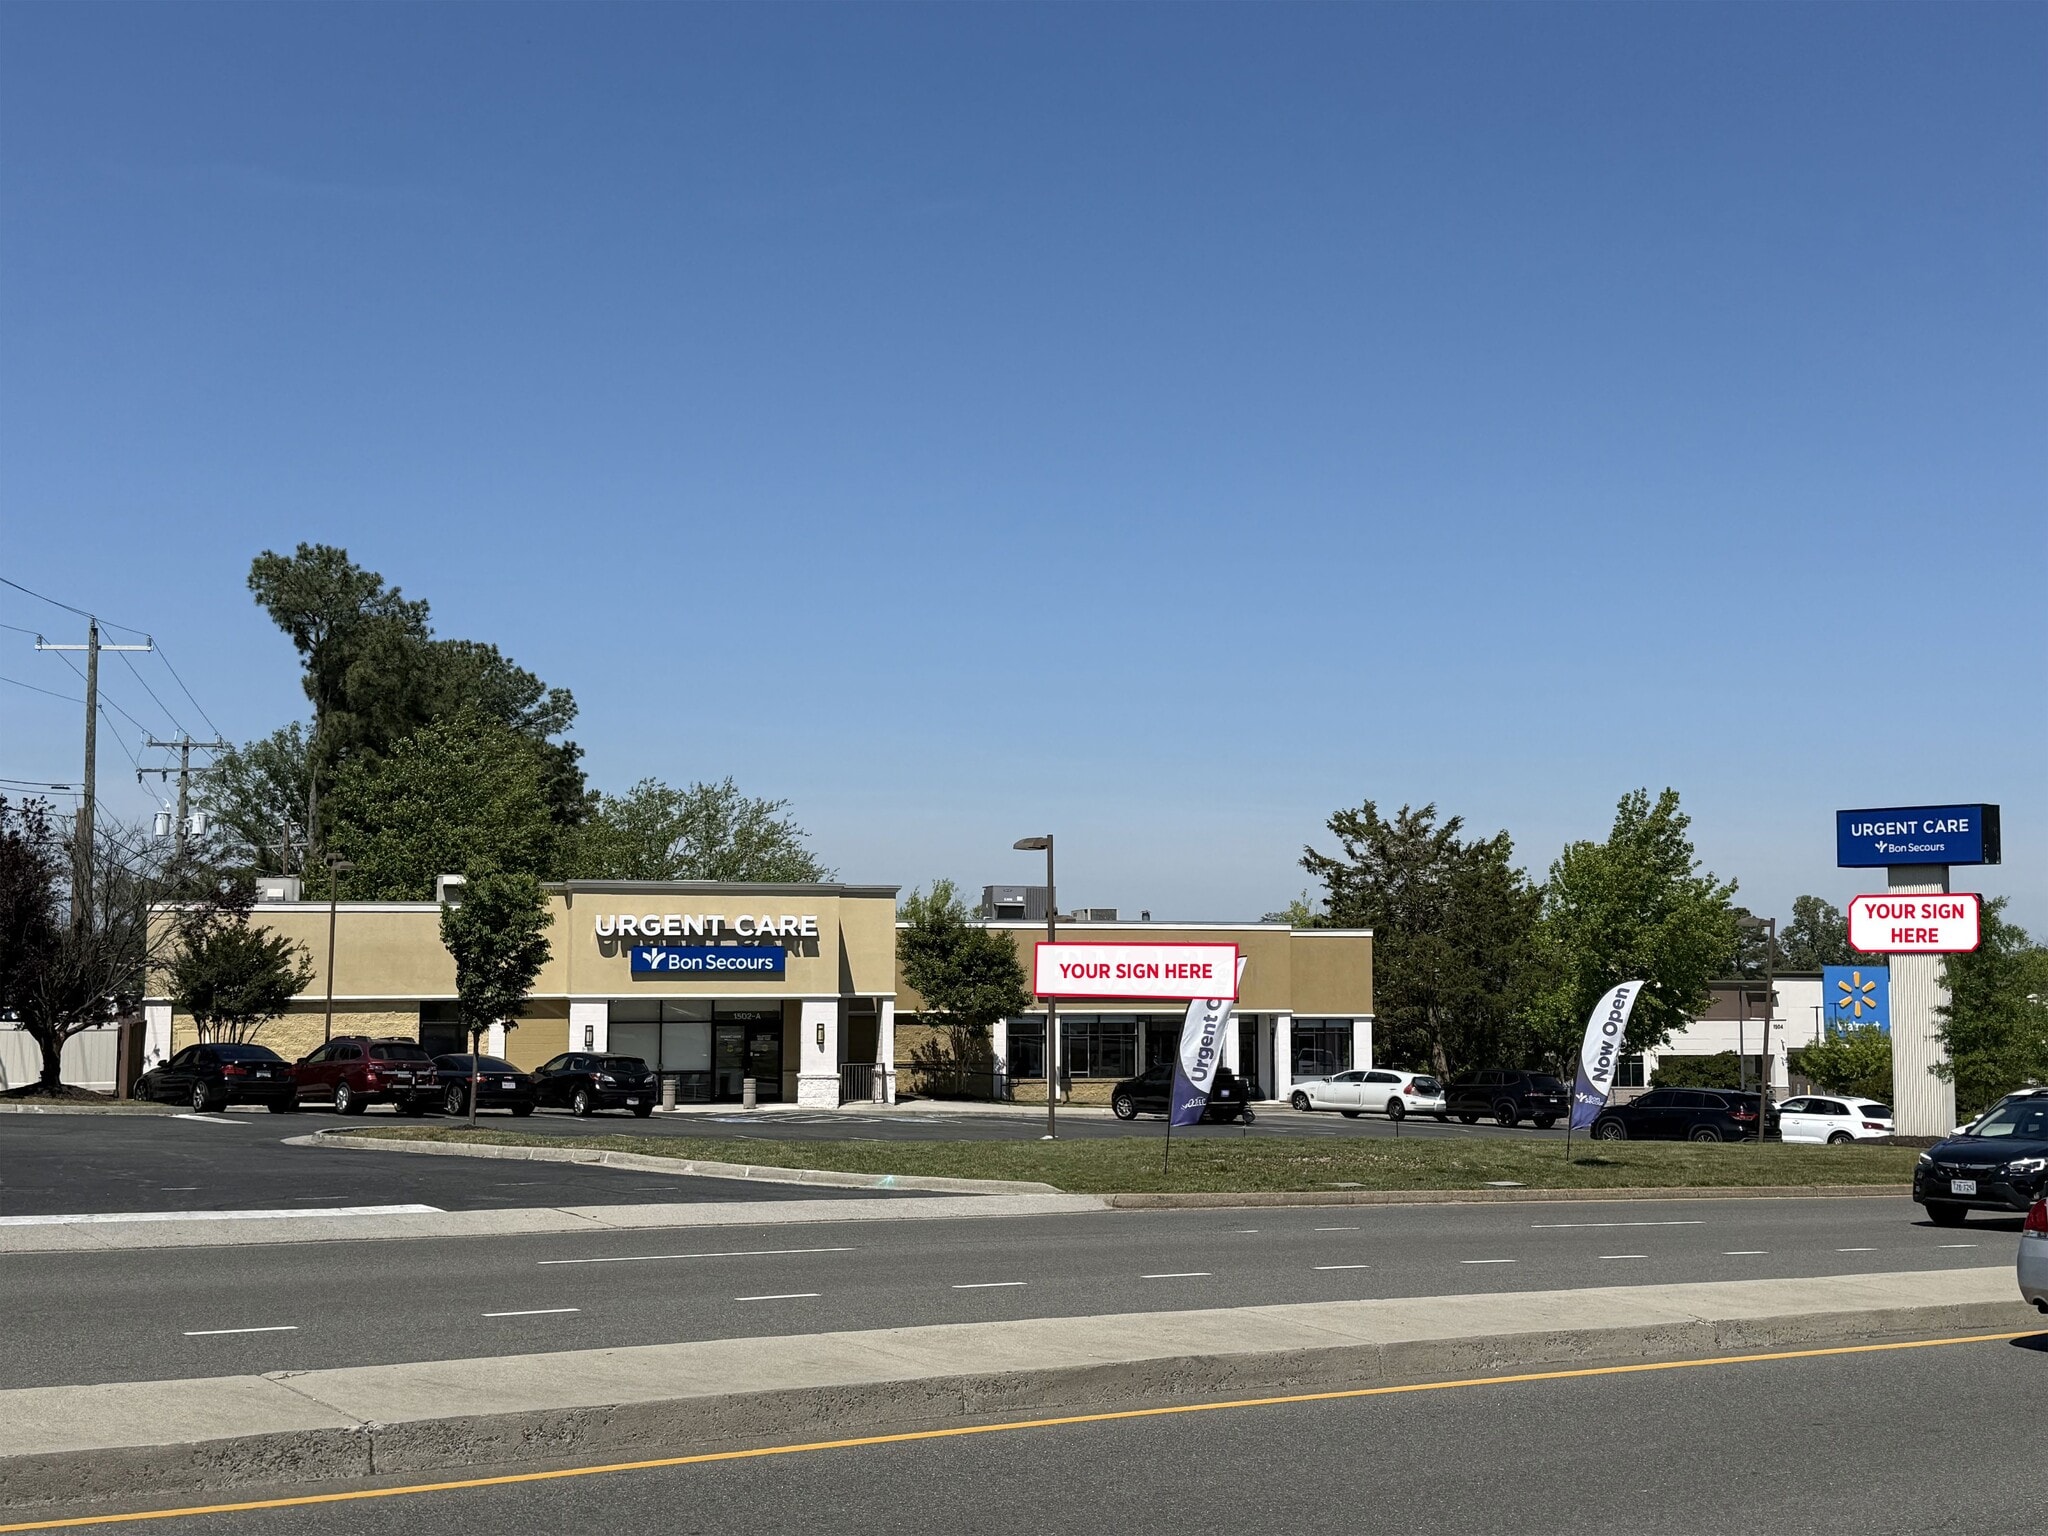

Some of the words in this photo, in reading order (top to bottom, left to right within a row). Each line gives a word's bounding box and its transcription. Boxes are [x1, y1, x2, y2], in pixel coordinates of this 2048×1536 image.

[1851, 820, 1918, 836] URGENT
[1923, 818, 1970, 833] CARE
[1889, 842, 1907, 853] Bon
[1908, 842, 1945, 852] Secours
[595, 914, 725, 937] URGENT
[734, 914, 818, 937] CARE
[668, 954, 702, 969] Bon
[705, 954, 773, 970] Secours
[1602, 987, 1630, 1037] Open
[1836, 1021, 1880, 1032] Walmt
[1191, 1013, 1221, 1082] Urgent
[1592, 1041, 1614, 1083] Now
